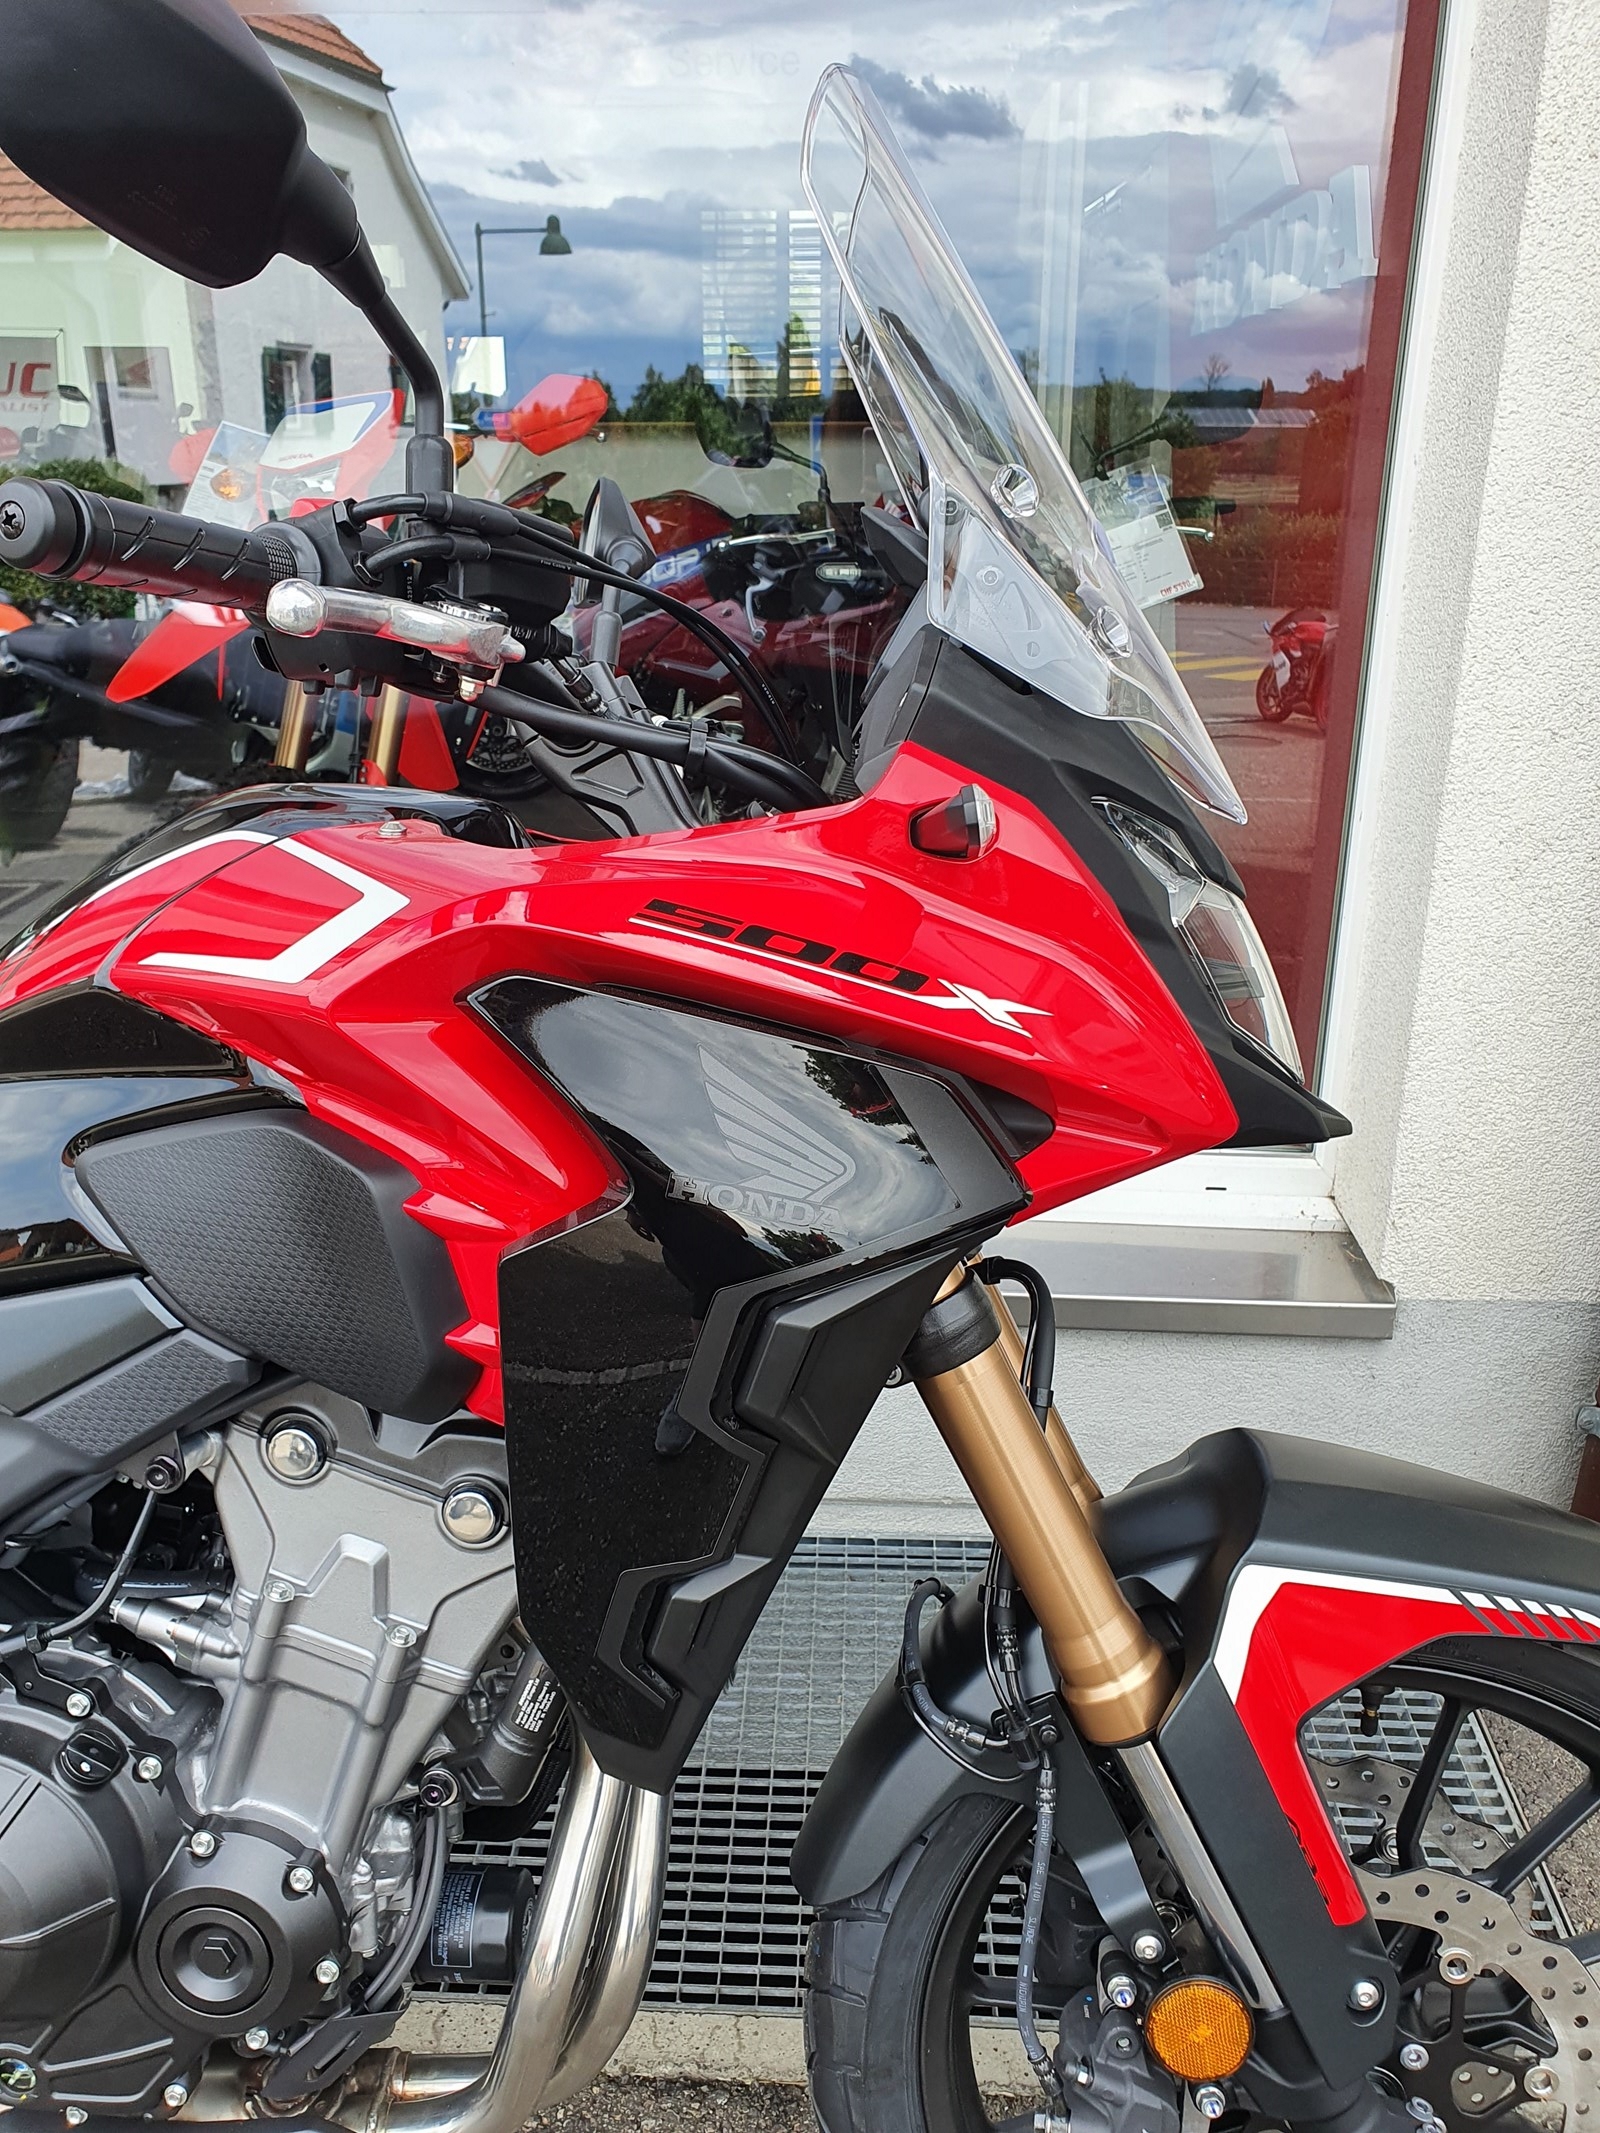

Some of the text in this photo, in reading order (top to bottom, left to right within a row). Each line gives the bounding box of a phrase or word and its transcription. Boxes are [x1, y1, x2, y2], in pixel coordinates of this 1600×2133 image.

[668, 46, 801, 77] Service
[666, 1171, 848, 1237] HONDA
[518, 1678, 533, 1705] HONDA
[464, 1902, 472, 1931] ATTENTION
